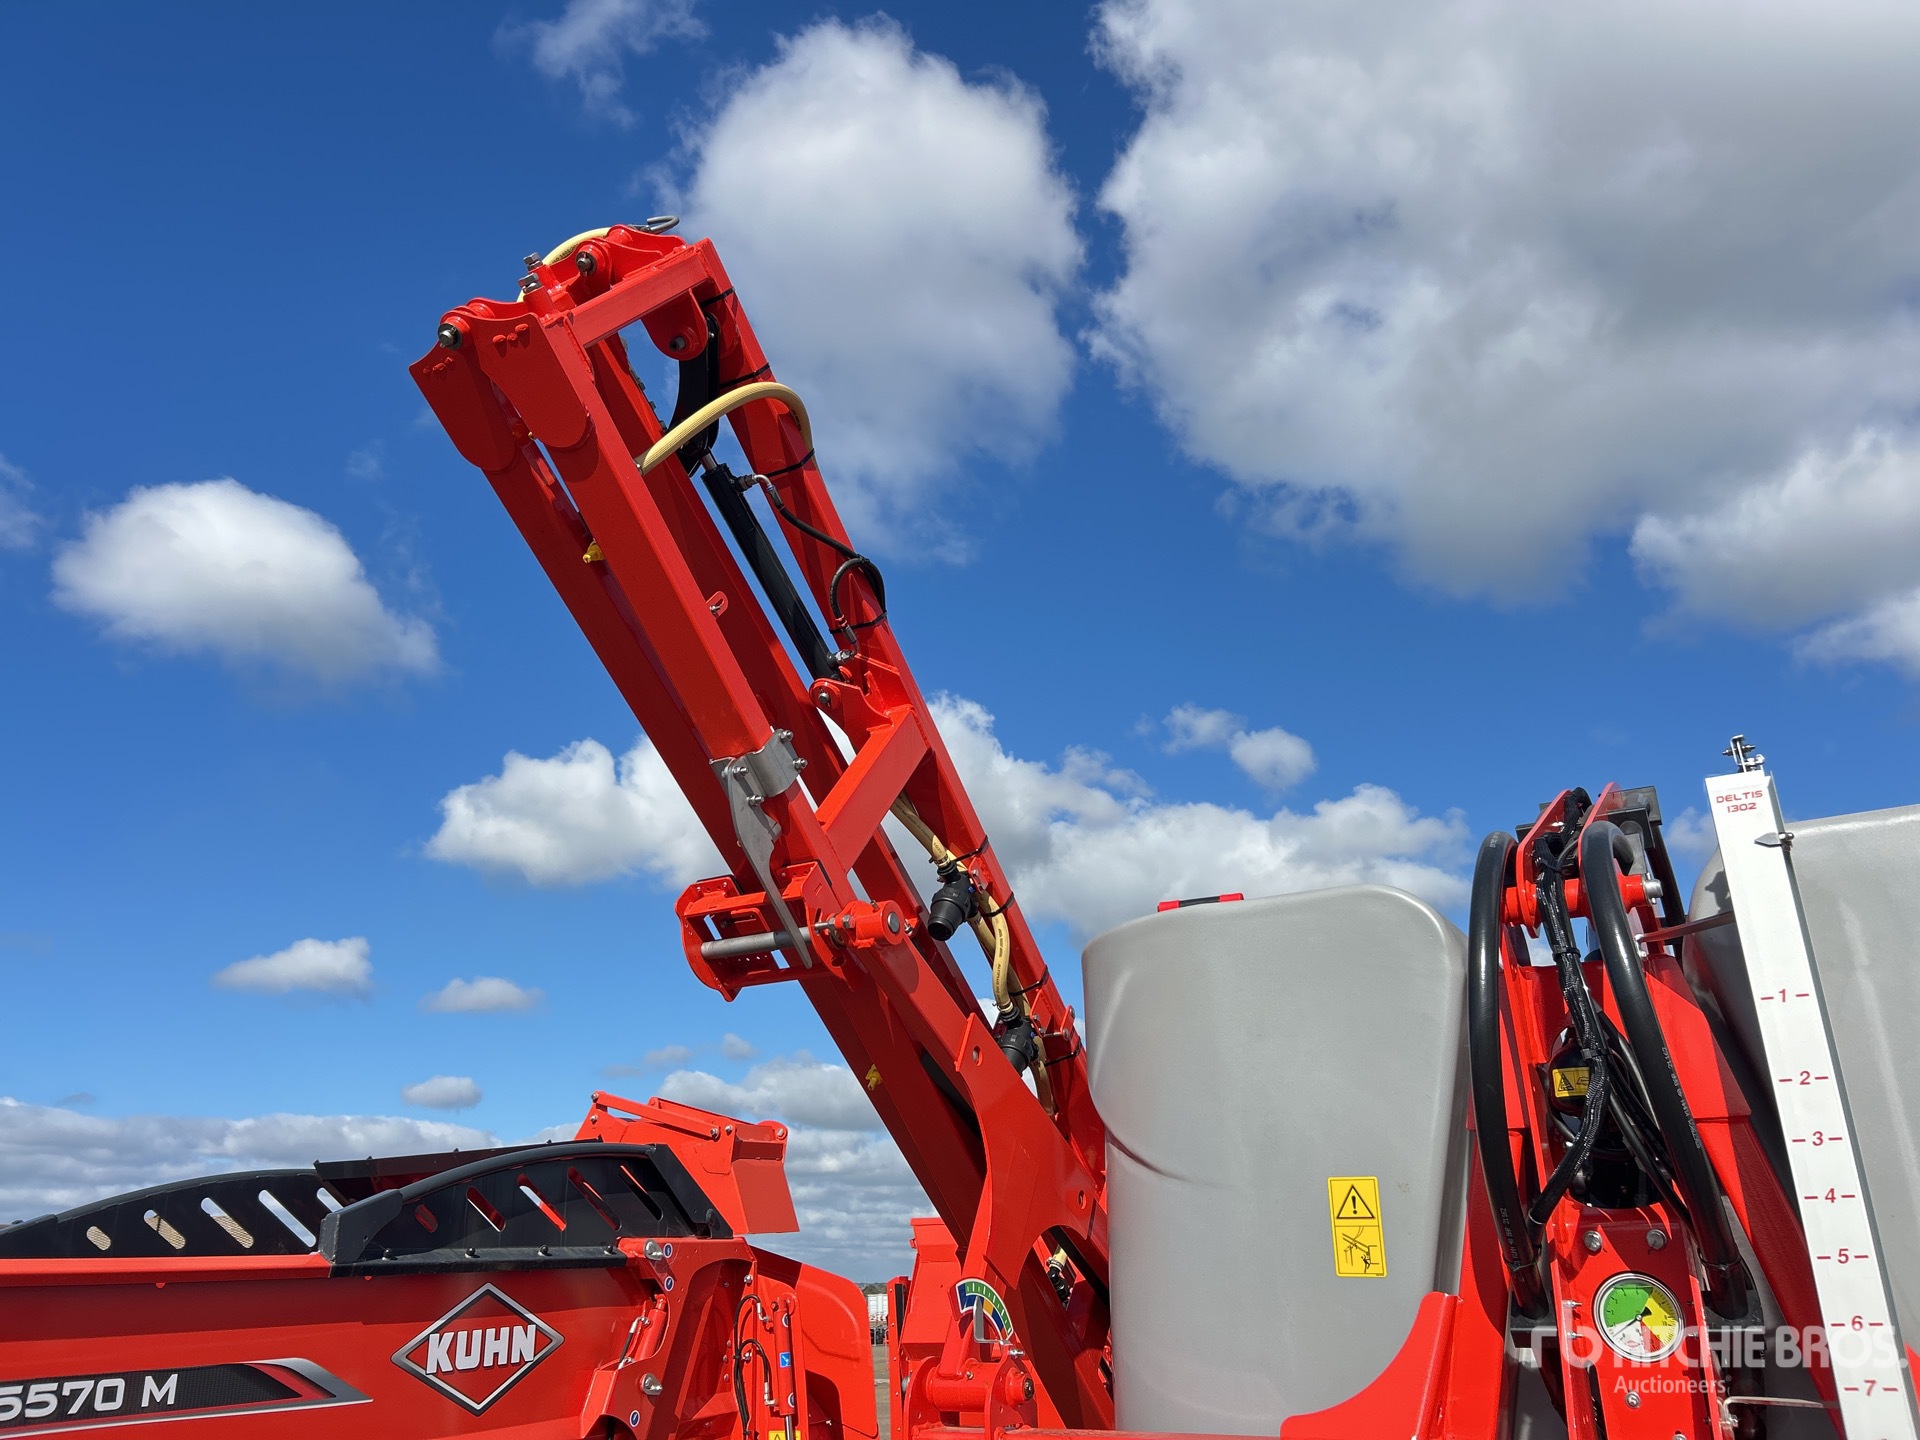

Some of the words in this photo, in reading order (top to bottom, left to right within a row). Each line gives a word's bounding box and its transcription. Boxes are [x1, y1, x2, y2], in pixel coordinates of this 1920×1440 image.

[1716, 790, 1763, 803] DELTIS
[1727, 803, 1757, 813] 1302
[426, 1324, 536, 1374] KUHN
[0, 1378, 126, 1421] 5570
[141, 1373, 179, 1408] M
